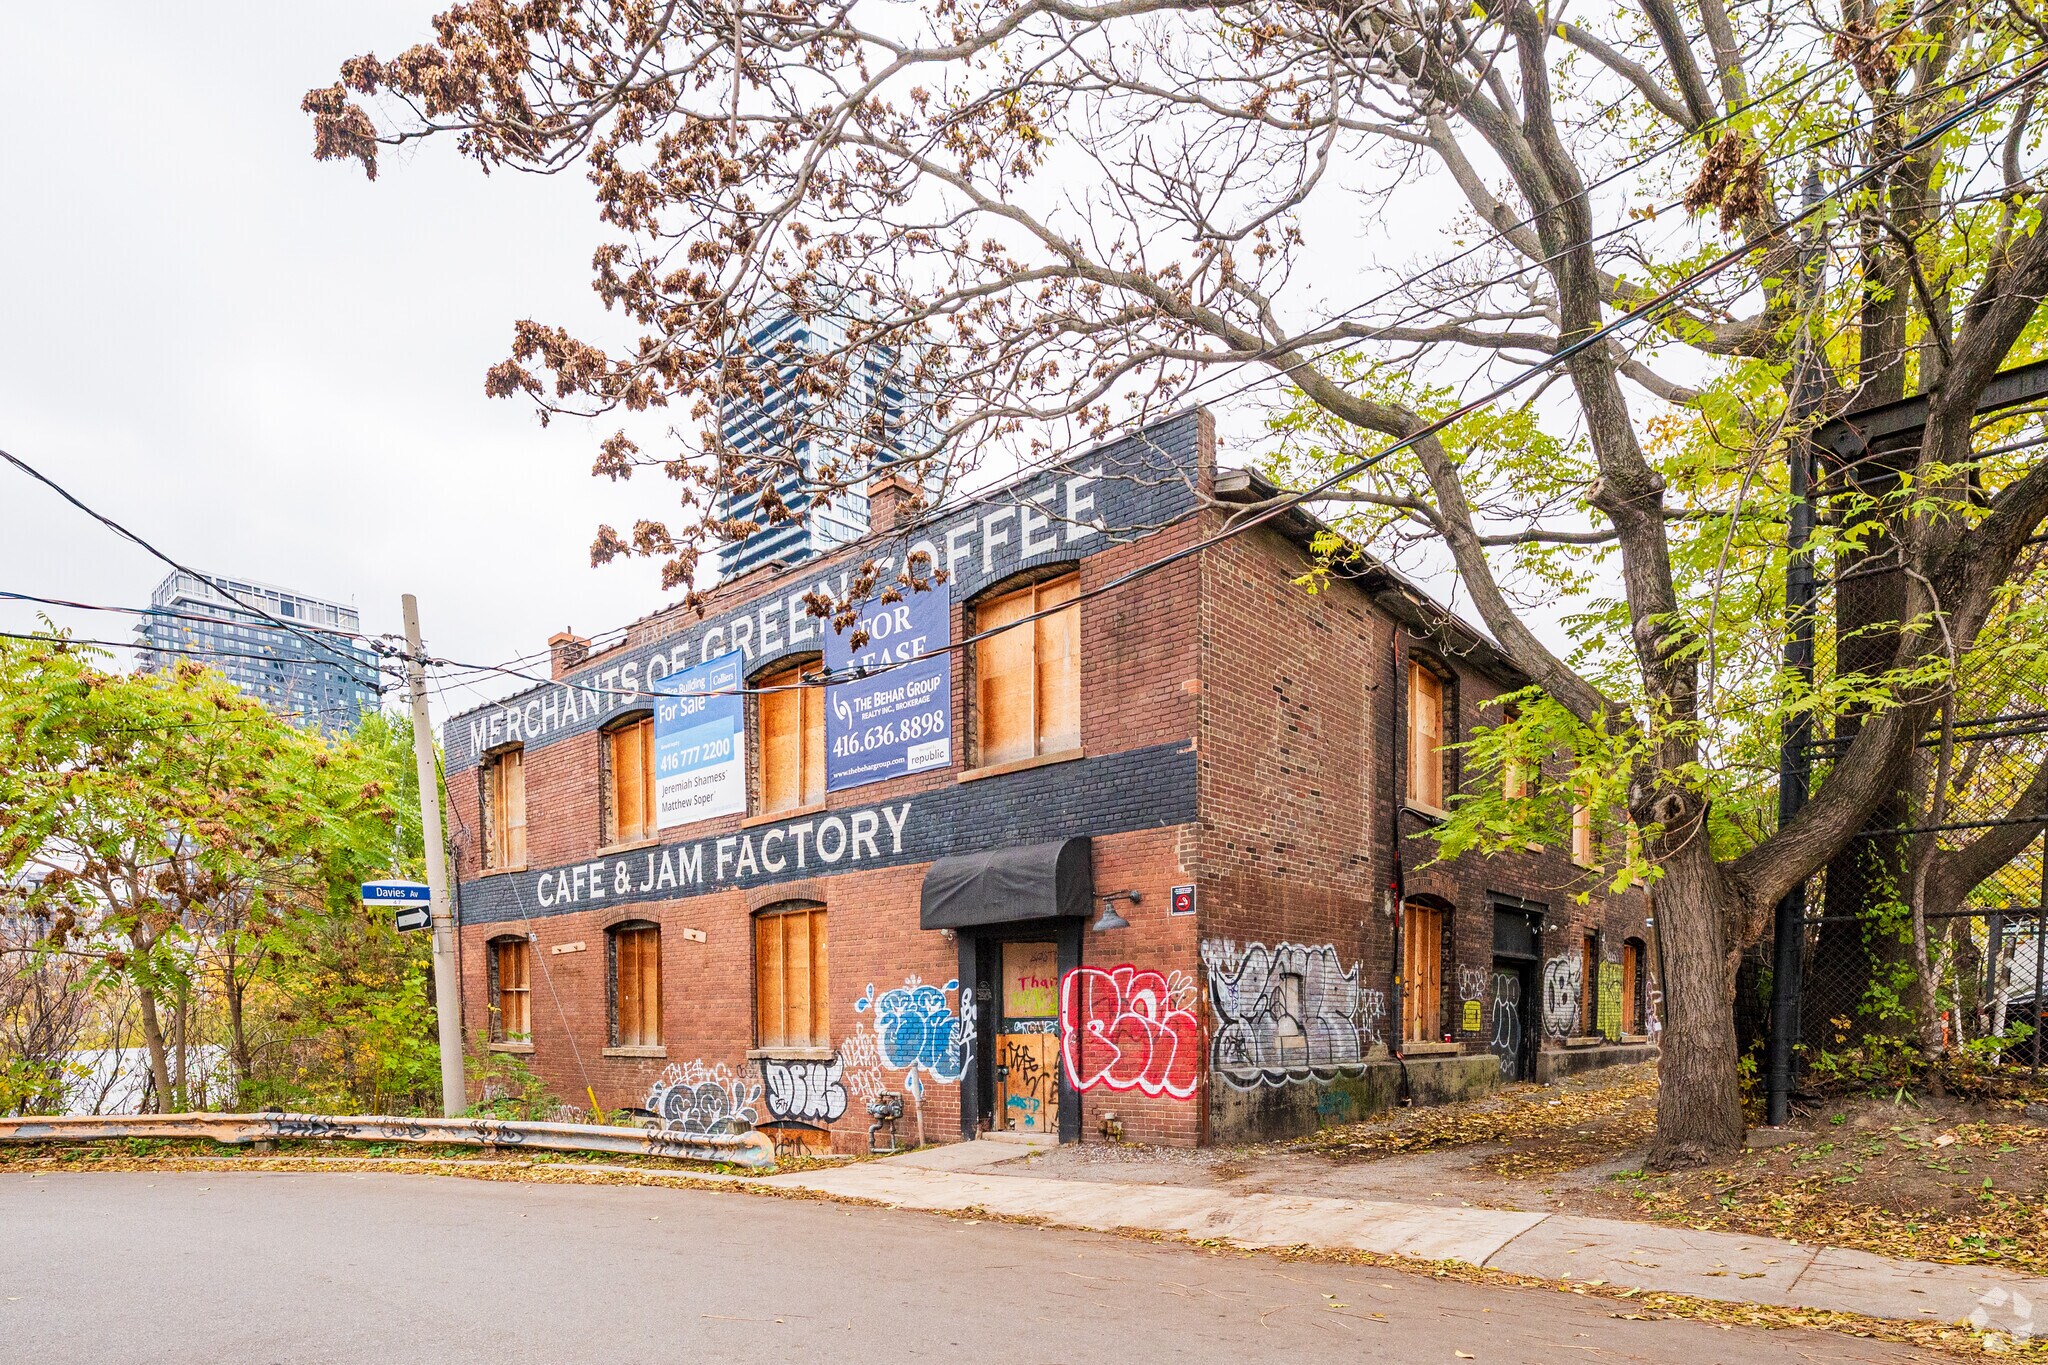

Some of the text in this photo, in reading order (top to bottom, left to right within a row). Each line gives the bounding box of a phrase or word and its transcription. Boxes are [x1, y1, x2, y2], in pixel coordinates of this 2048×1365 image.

[857, 605, 913, 640] FOR
[470, 661, 639, 757] MERCHANTS
[647, 641, 689, 693] OF
[702, 572, 849, 662] GREEN
[847, 635, 927, 685] LEASE
[678, 677, 706, 693] Building
[713, 673, 734, 686] Colliers
[853, 676, 940, 713] THE BEHAR GROUP
[861, 708, 881, 720] REALTY
[895, 694, 931, 711] BROKERAGE
[659, 696, 706, 723] For Sale
[832, 709, 945, 758] 416.636.8898
[660, 752, 679, 772] 416
[680, 746, 700, 767] 777
[702, 738, 730, 761] 2200
[832, 757, 905, 778] www.thebehargroup.com
[911, 748, 945, 765] republic
[662, 777, 693, 798] Jeremiah
[661, 793, 714, 812] Matthew Soper
[537, 803, 912, 908] CAFE & JAM FACTORY
[376, 887, 405, 897] Davies
